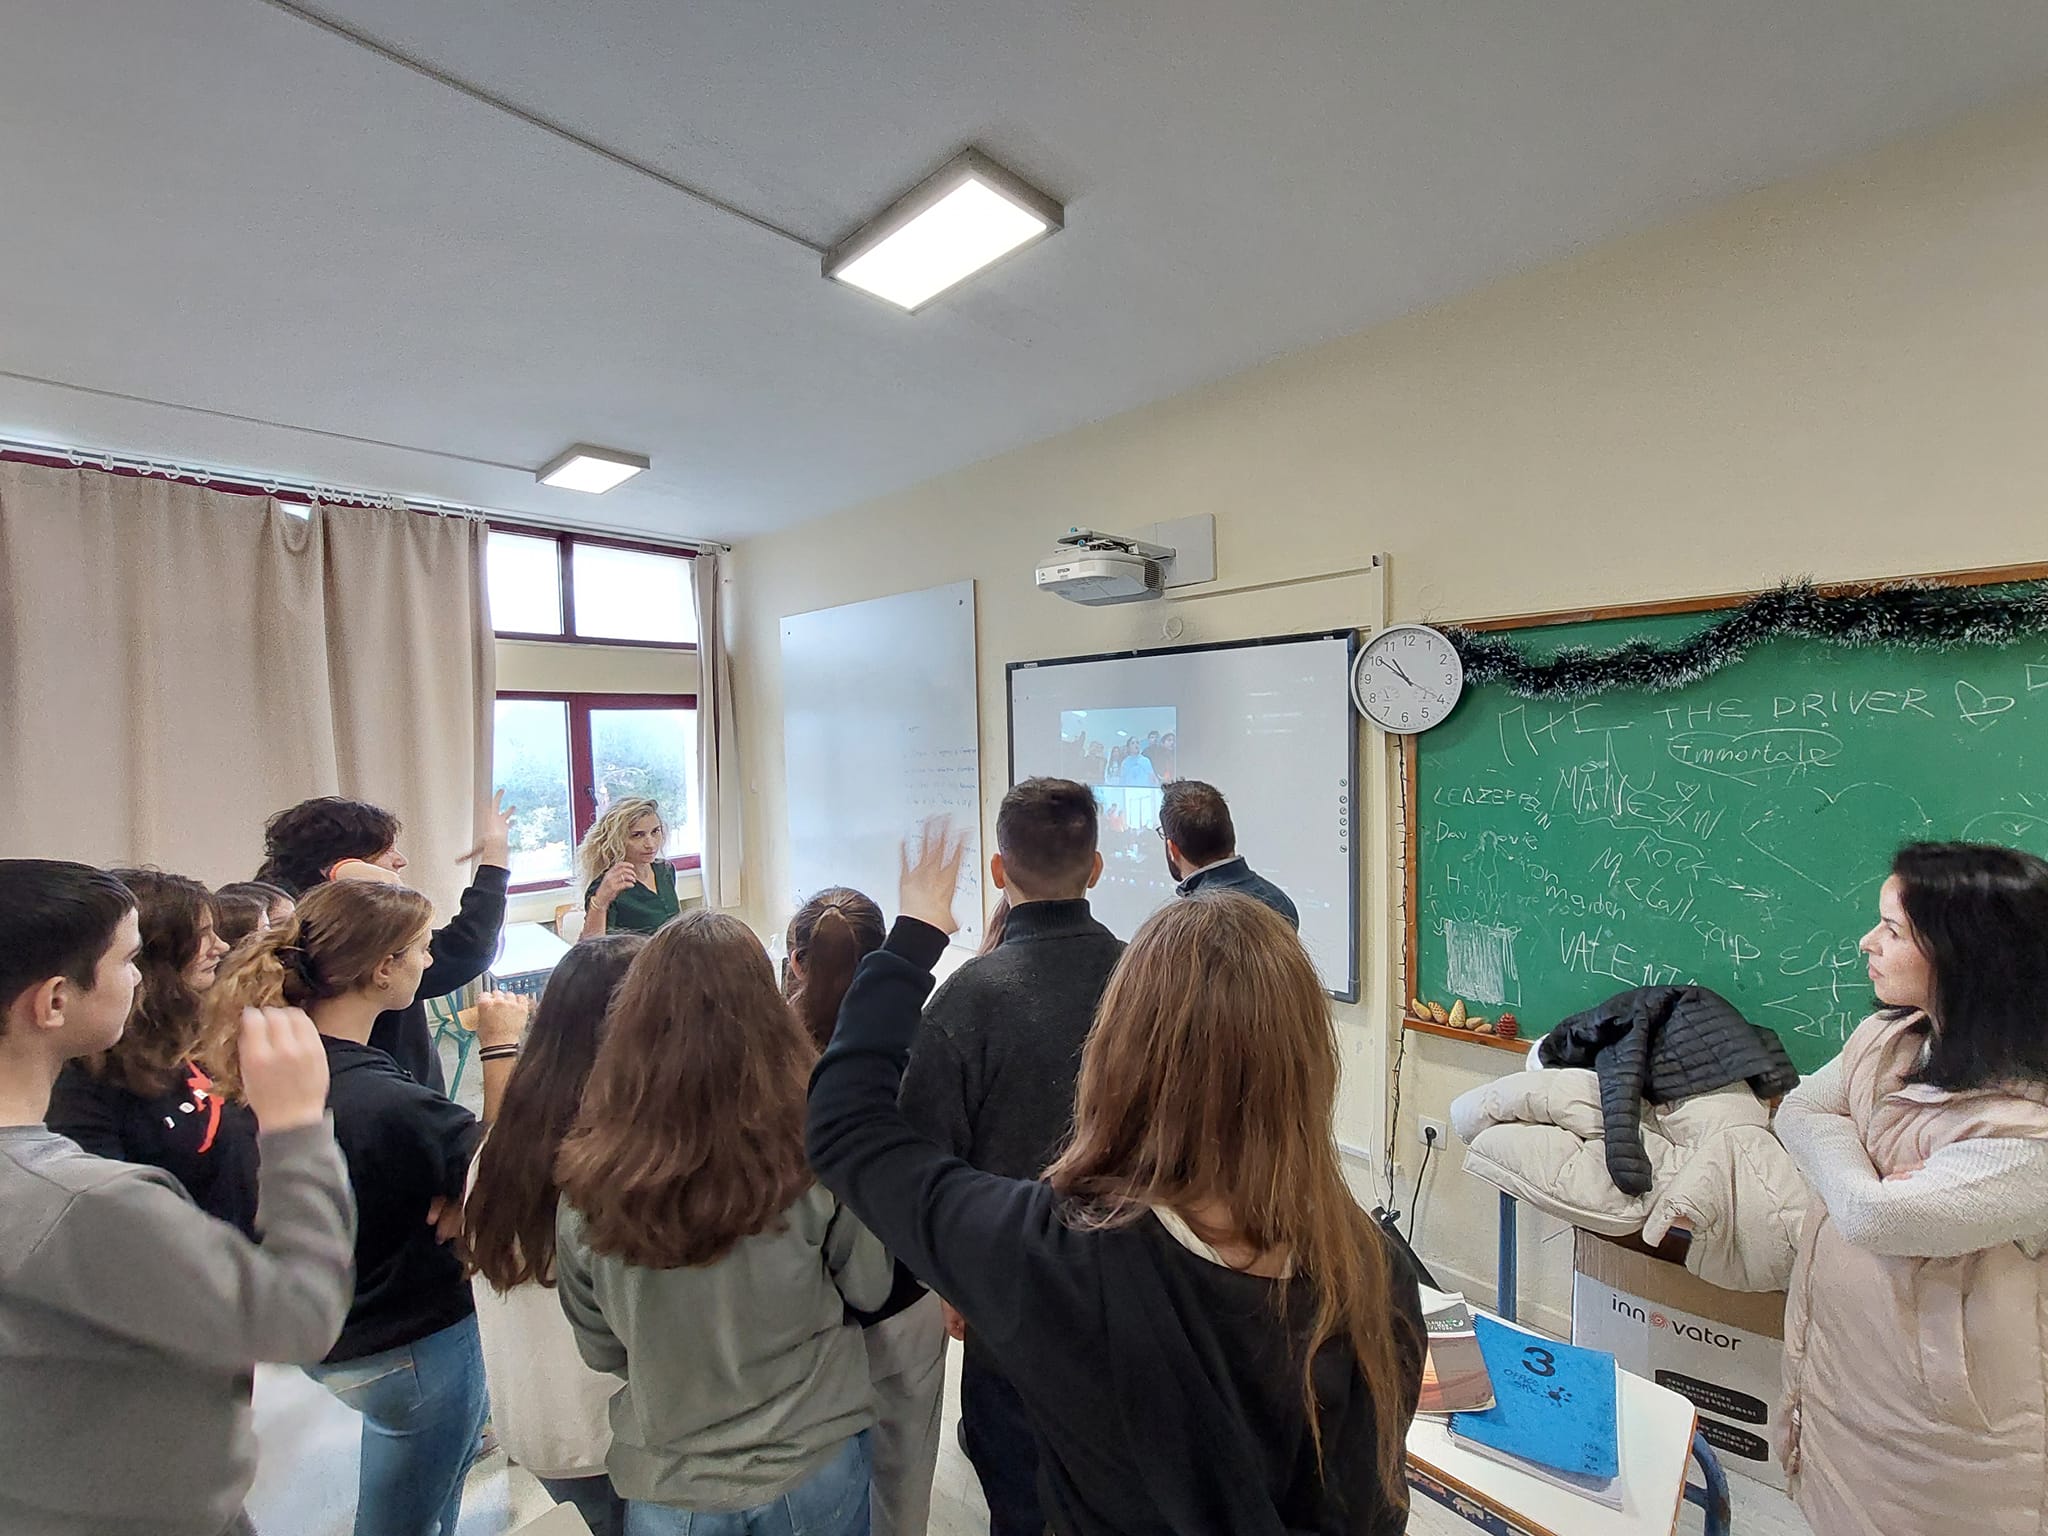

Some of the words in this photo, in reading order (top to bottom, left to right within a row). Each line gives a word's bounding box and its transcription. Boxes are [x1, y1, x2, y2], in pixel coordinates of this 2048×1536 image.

[1384, 641, 1395, 652] 11
[1402, 634, 1416, 647] 12
[1370, 655, 1383, 667] 10
[1440, 653, 1448, 665] 2
[1364, 673, 1372, 684] 9
[1444, 673, 1453, 685] 3
[1369, 692, 1377, 704] 8
[1436, 693, 1445, 704] 4
[1383, 706, 1390, 717] 7
[1421, 707, 1429, 719] 5
[1653, 698, 1752, 730] THE
[1772, 687, 1935, 719] DRIVER
[1401, 711, 1409, 723] 6
[1632, 834, 1713, 882] ROCK
[1521, 1346, 1556, 1377] 3
[1711, 1398, 1757, 1418] equipment
